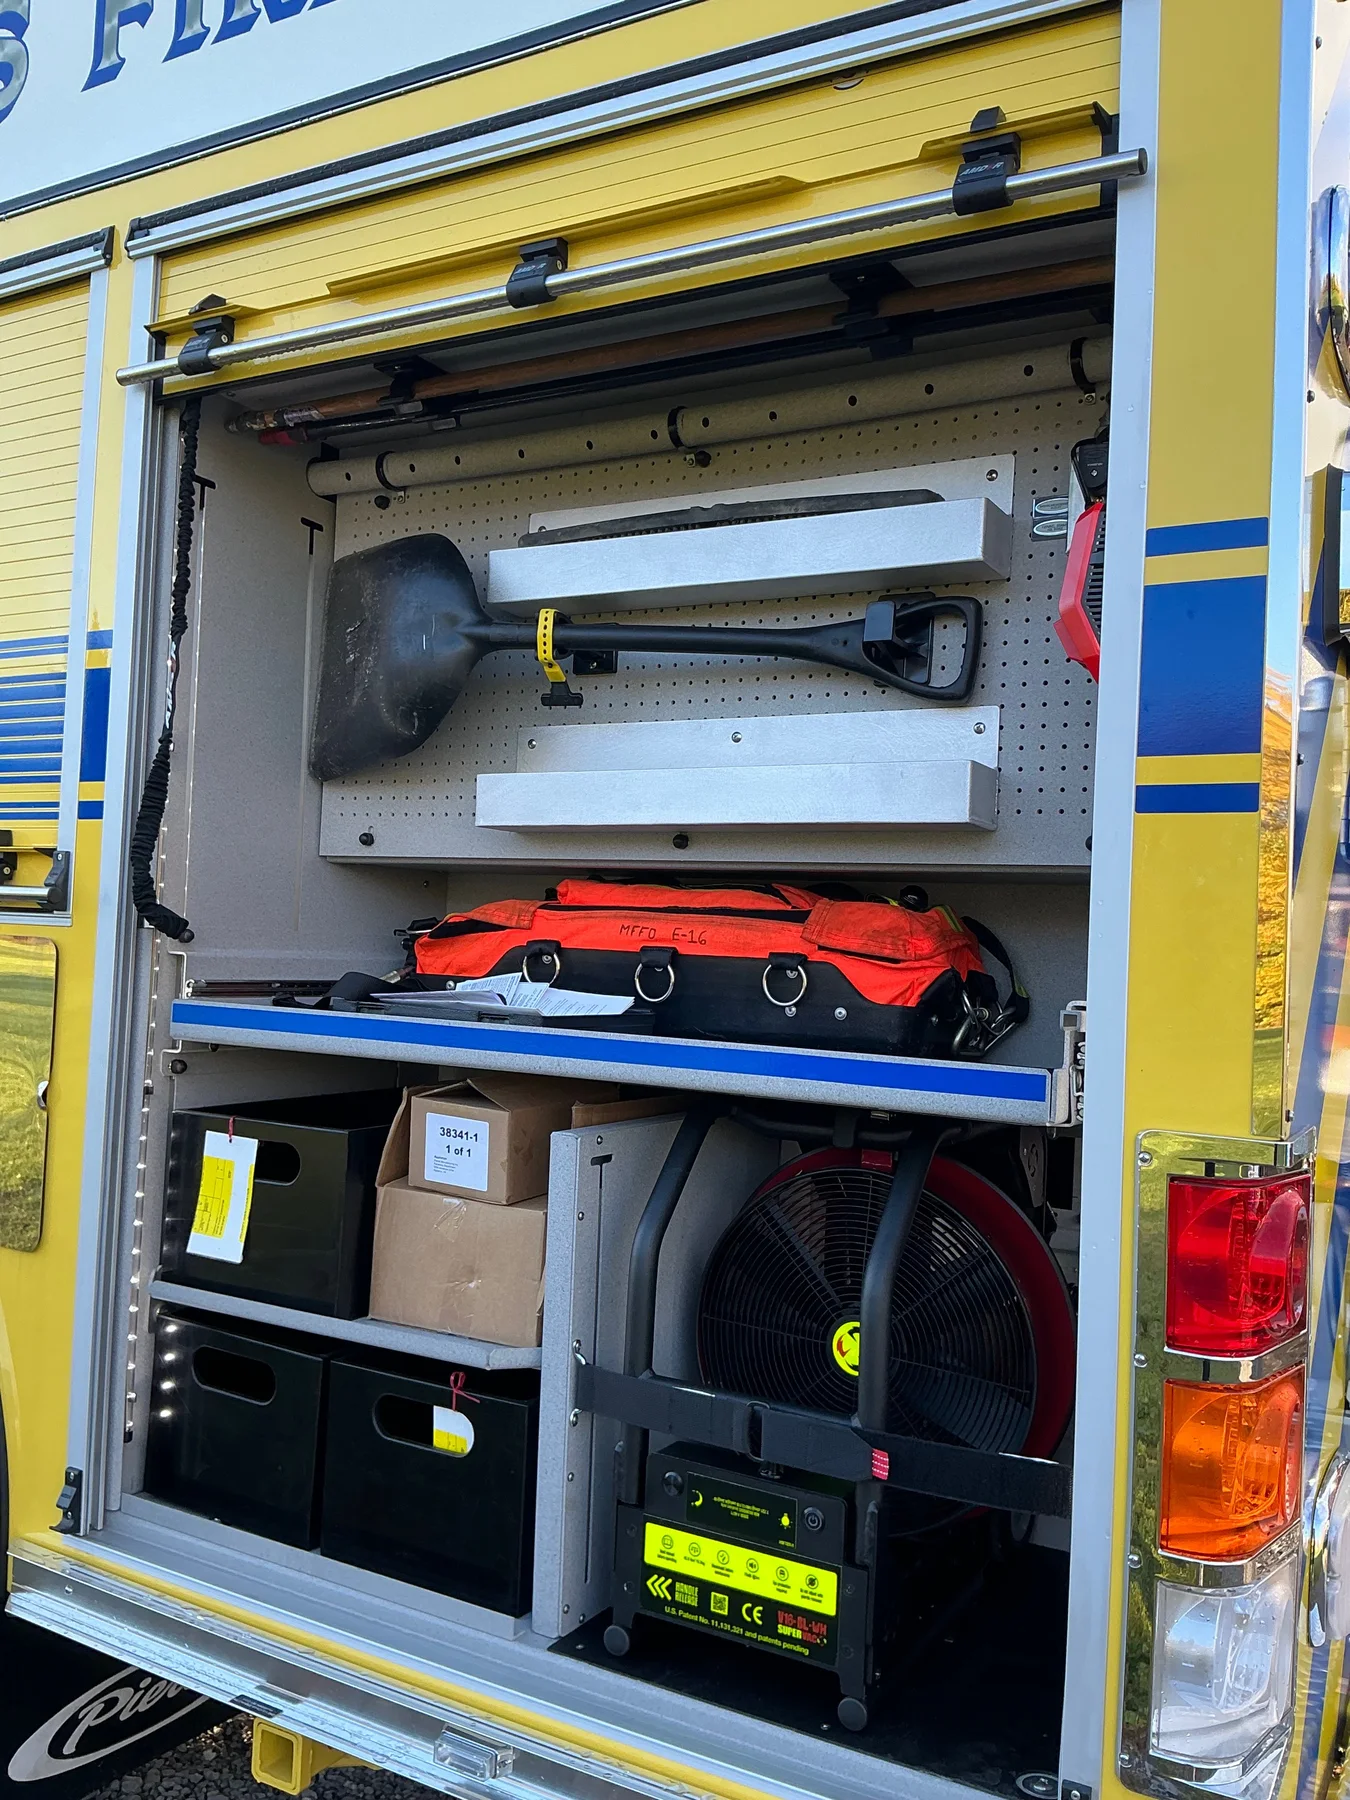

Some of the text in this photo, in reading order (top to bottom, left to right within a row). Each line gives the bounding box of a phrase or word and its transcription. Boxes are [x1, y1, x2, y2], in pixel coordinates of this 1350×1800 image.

[672, 927, 707, 945] E-16
[440, 1127, 478, 1142] 38341-1
[446, 1144, 471, 1157] 1 of 1
[742, 1603, 763, 1625] CE
[665, 1605, 677, 1616] U.S.
[679, 1610, 698, 1622] Patent
[699, 1615, 710, 1625] No.
[745, 1627, 757, 1638] and
[758, 1634, 782, 1648] patents
[783, 1641, 809, 1656] pending
